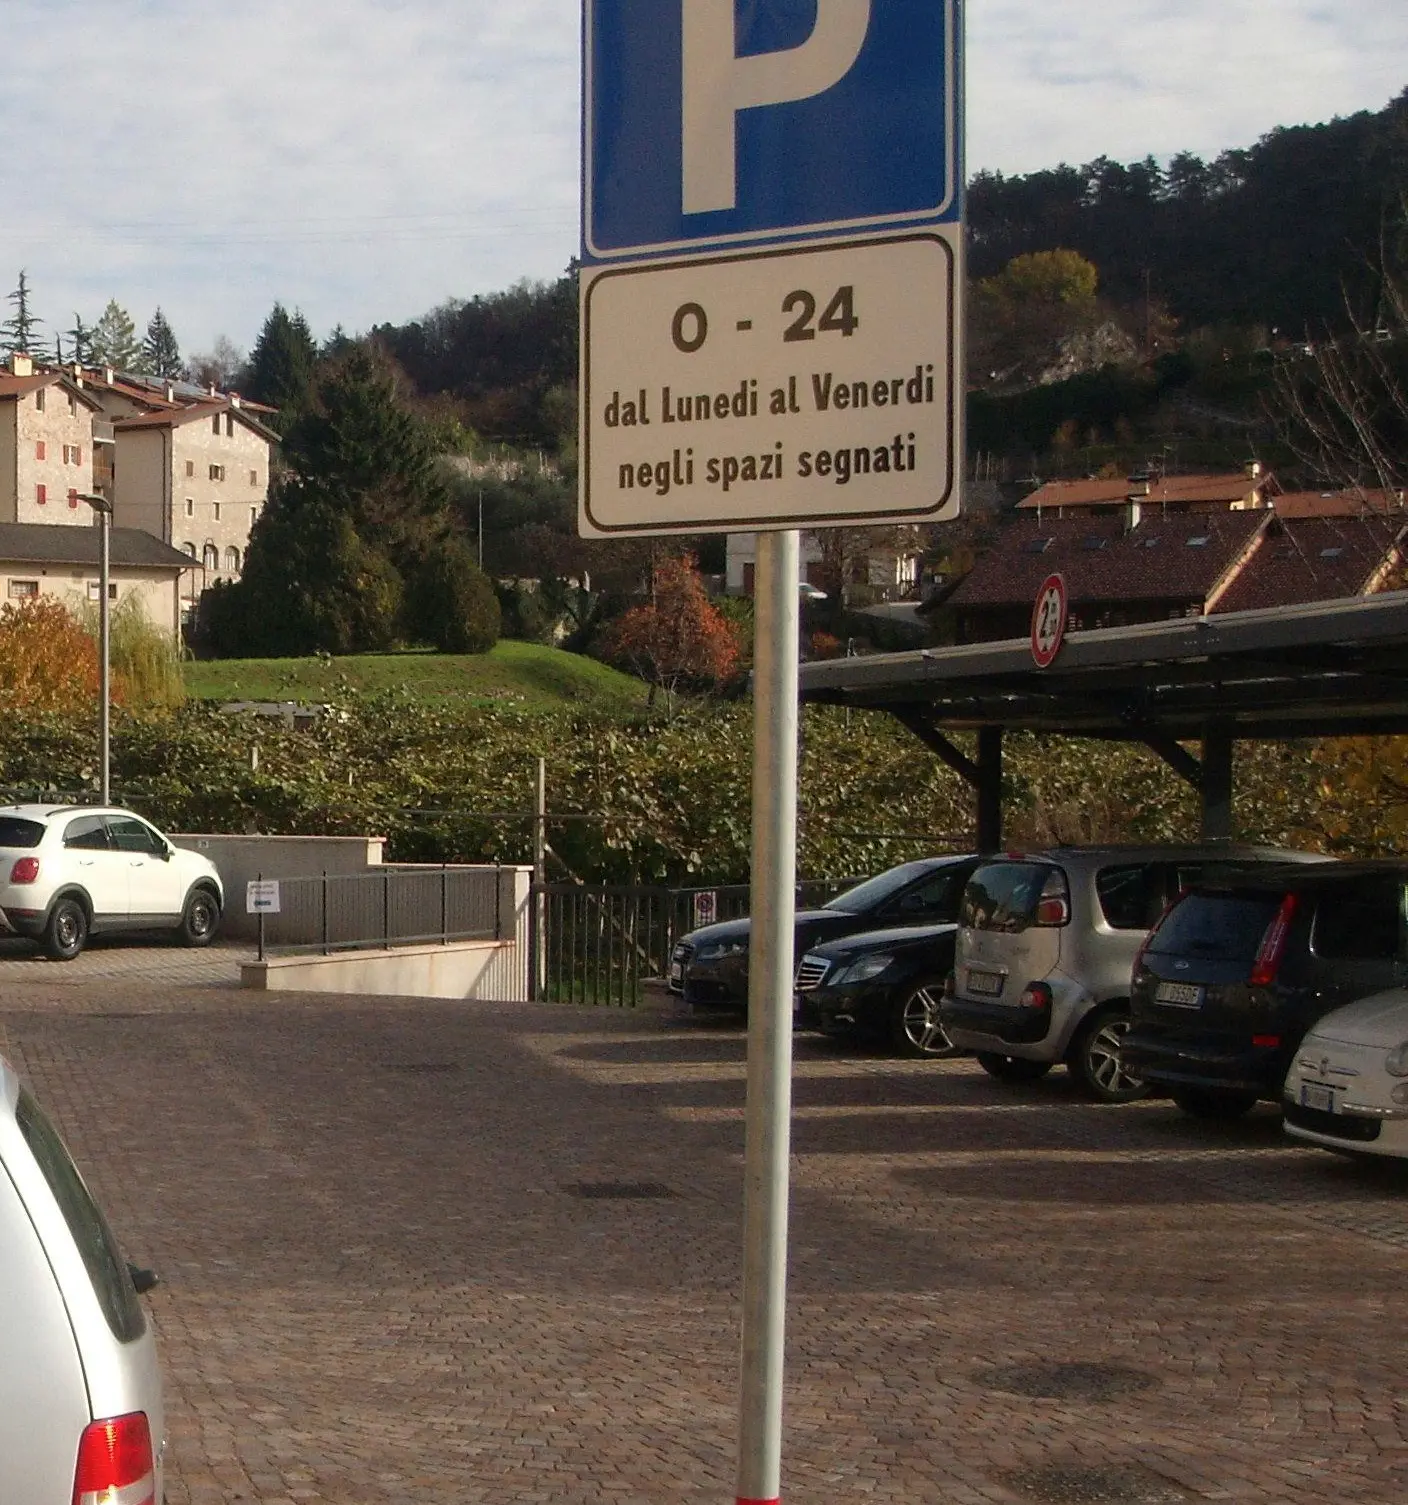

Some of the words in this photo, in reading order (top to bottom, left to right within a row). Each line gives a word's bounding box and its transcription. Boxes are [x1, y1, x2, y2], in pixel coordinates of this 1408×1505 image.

[682, 0, 871, 215] P
[671, 302, 709, 354] 0
[736, 319, 753, 332] -
[781, 285, 859, 343] 24
[604, 388, 651, 428] dal
[662, 379, 758, 424] Lunedi
[769, 375, 801, 415] al
[811, 363, 934, 412] Venerdi
[619, 447, 694, 496] negli
[705, 440, 783, 492] spazi
[797, 431, 916, 486] segnati
